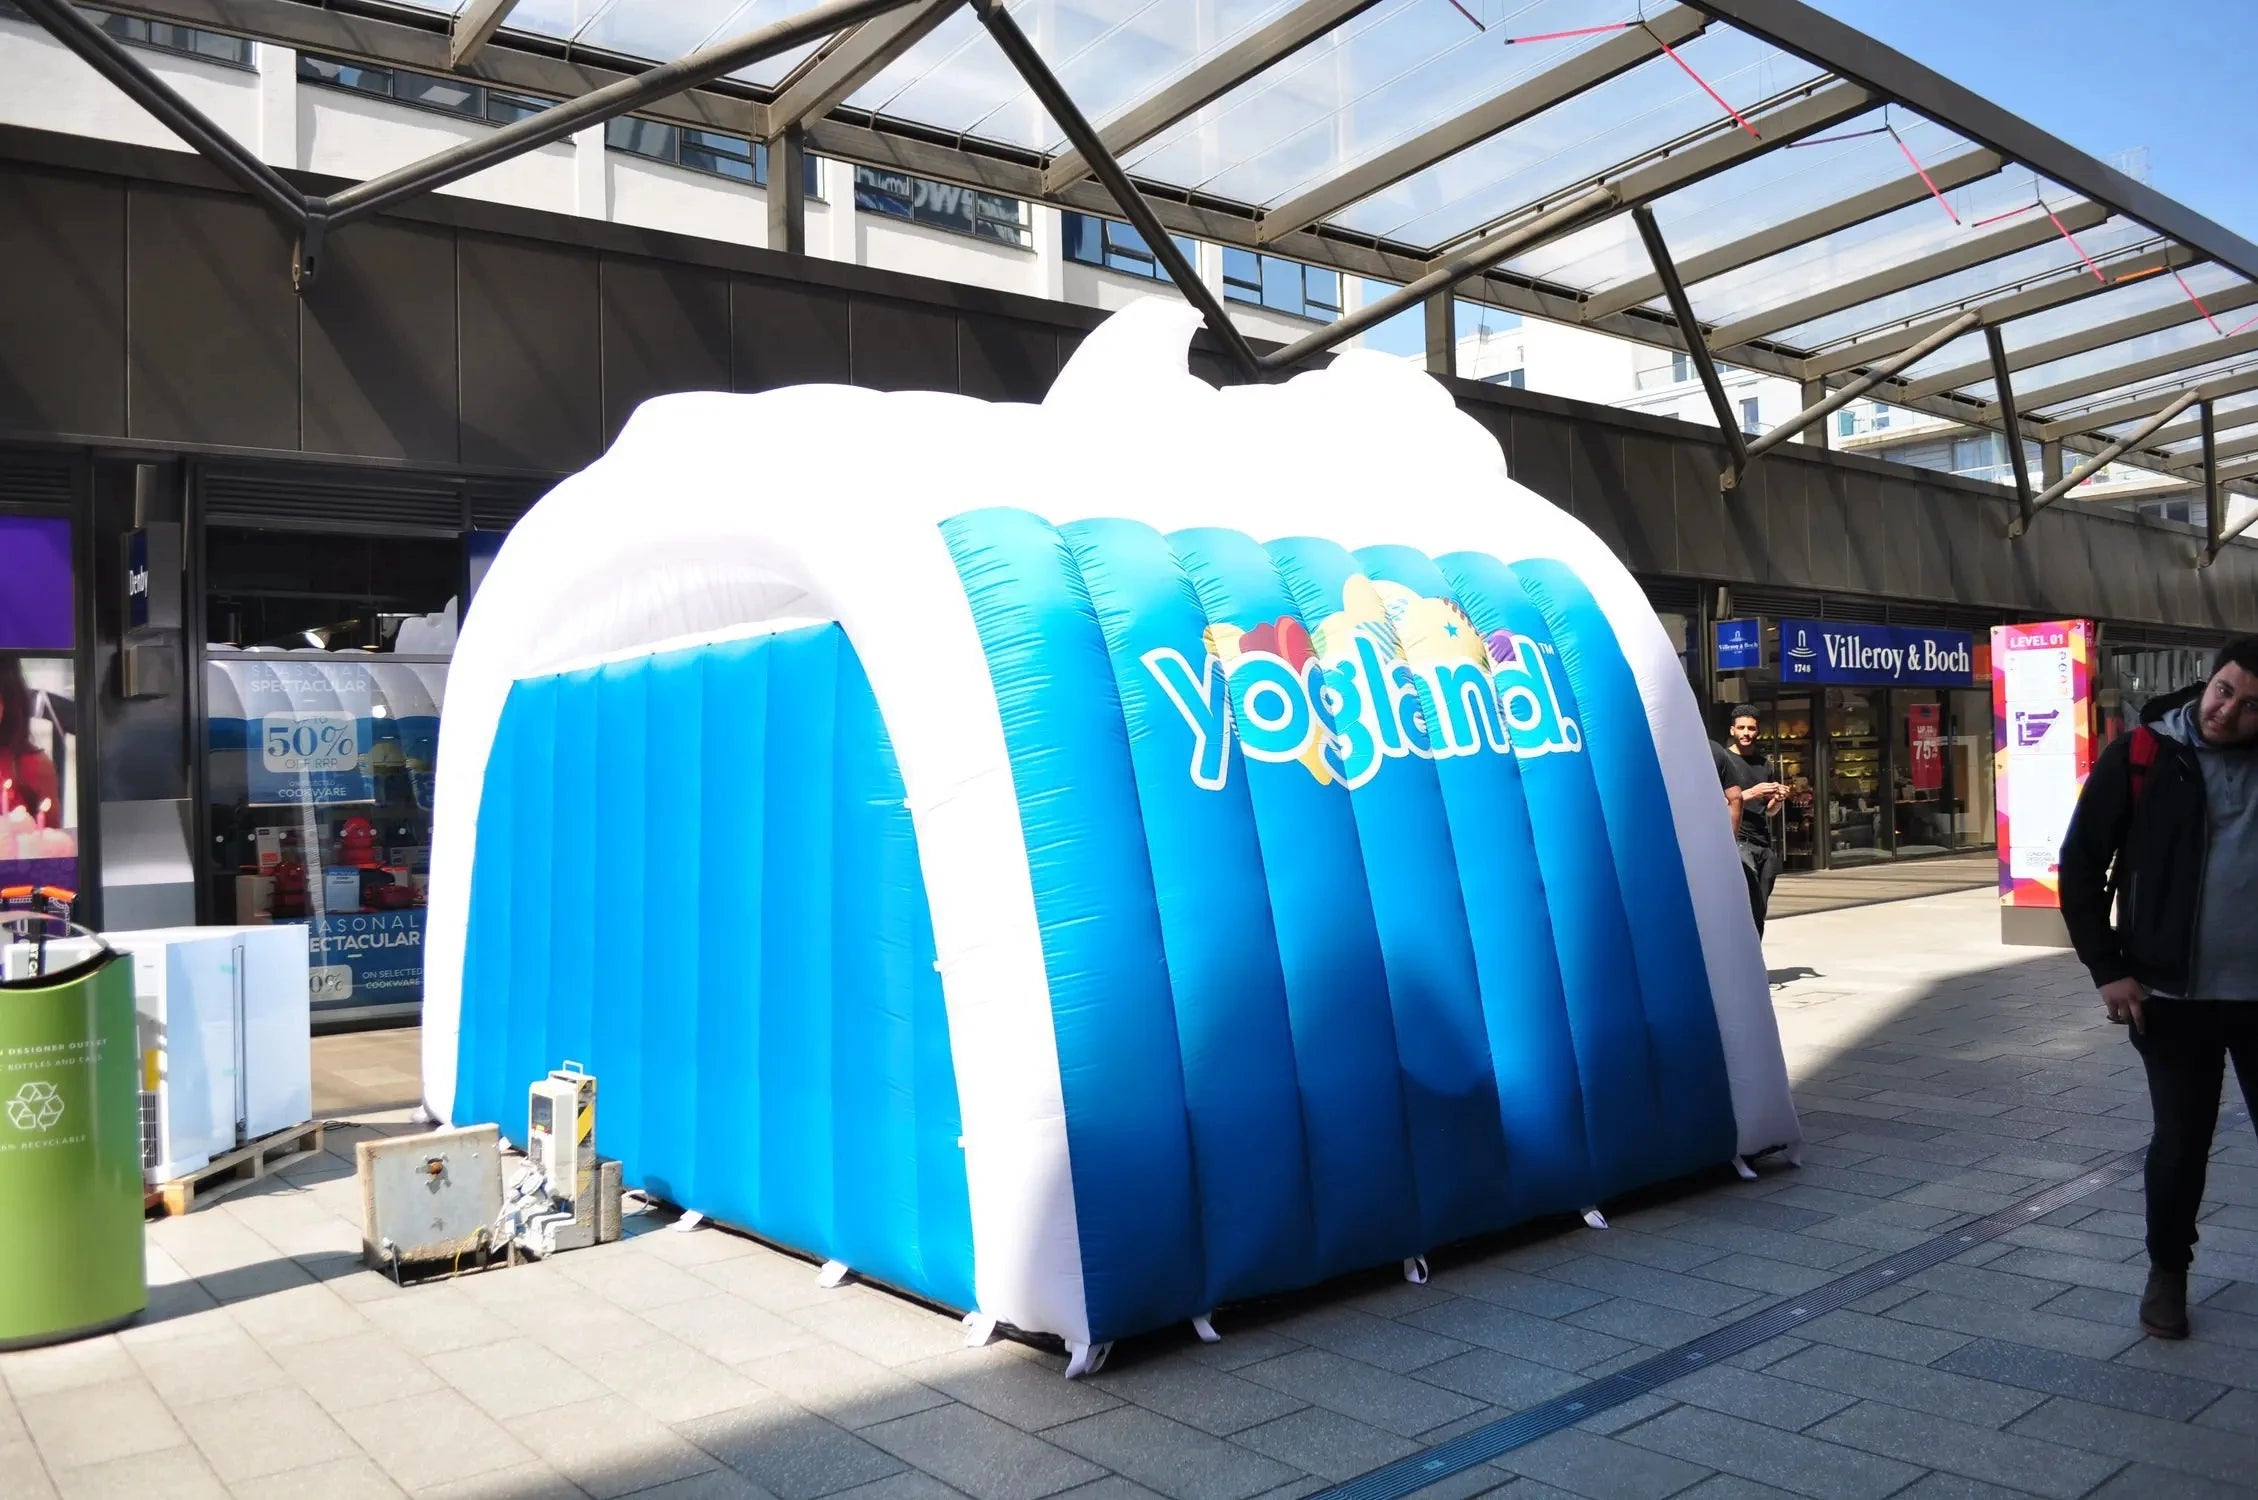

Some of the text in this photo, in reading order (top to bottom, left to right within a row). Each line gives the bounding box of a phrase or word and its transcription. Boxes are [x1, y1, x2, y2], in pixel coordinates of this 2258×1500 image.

[2010, 634, 2064, 648] LEVEL 01
[1823, 634, 1970, 678] Villeroy & Boch
[1794, 664, 1811, 673] 1748
[251, 680, 367, 692] SPECTACULAR
[268, 725, 353, 758] 50%
[315, 758, 337, 769] RRP
[278, 787, 347, 798] COOKWARE
[362, 971, 377, 980] ON
[379, 967, 423, 978] SELECTED
[365, 978, 420, 989] COOKWARE
[8, 1038, 107, 1056] DESIGNER OUTLET
[21, 1134, 86, 1150] RECYCLABLE
